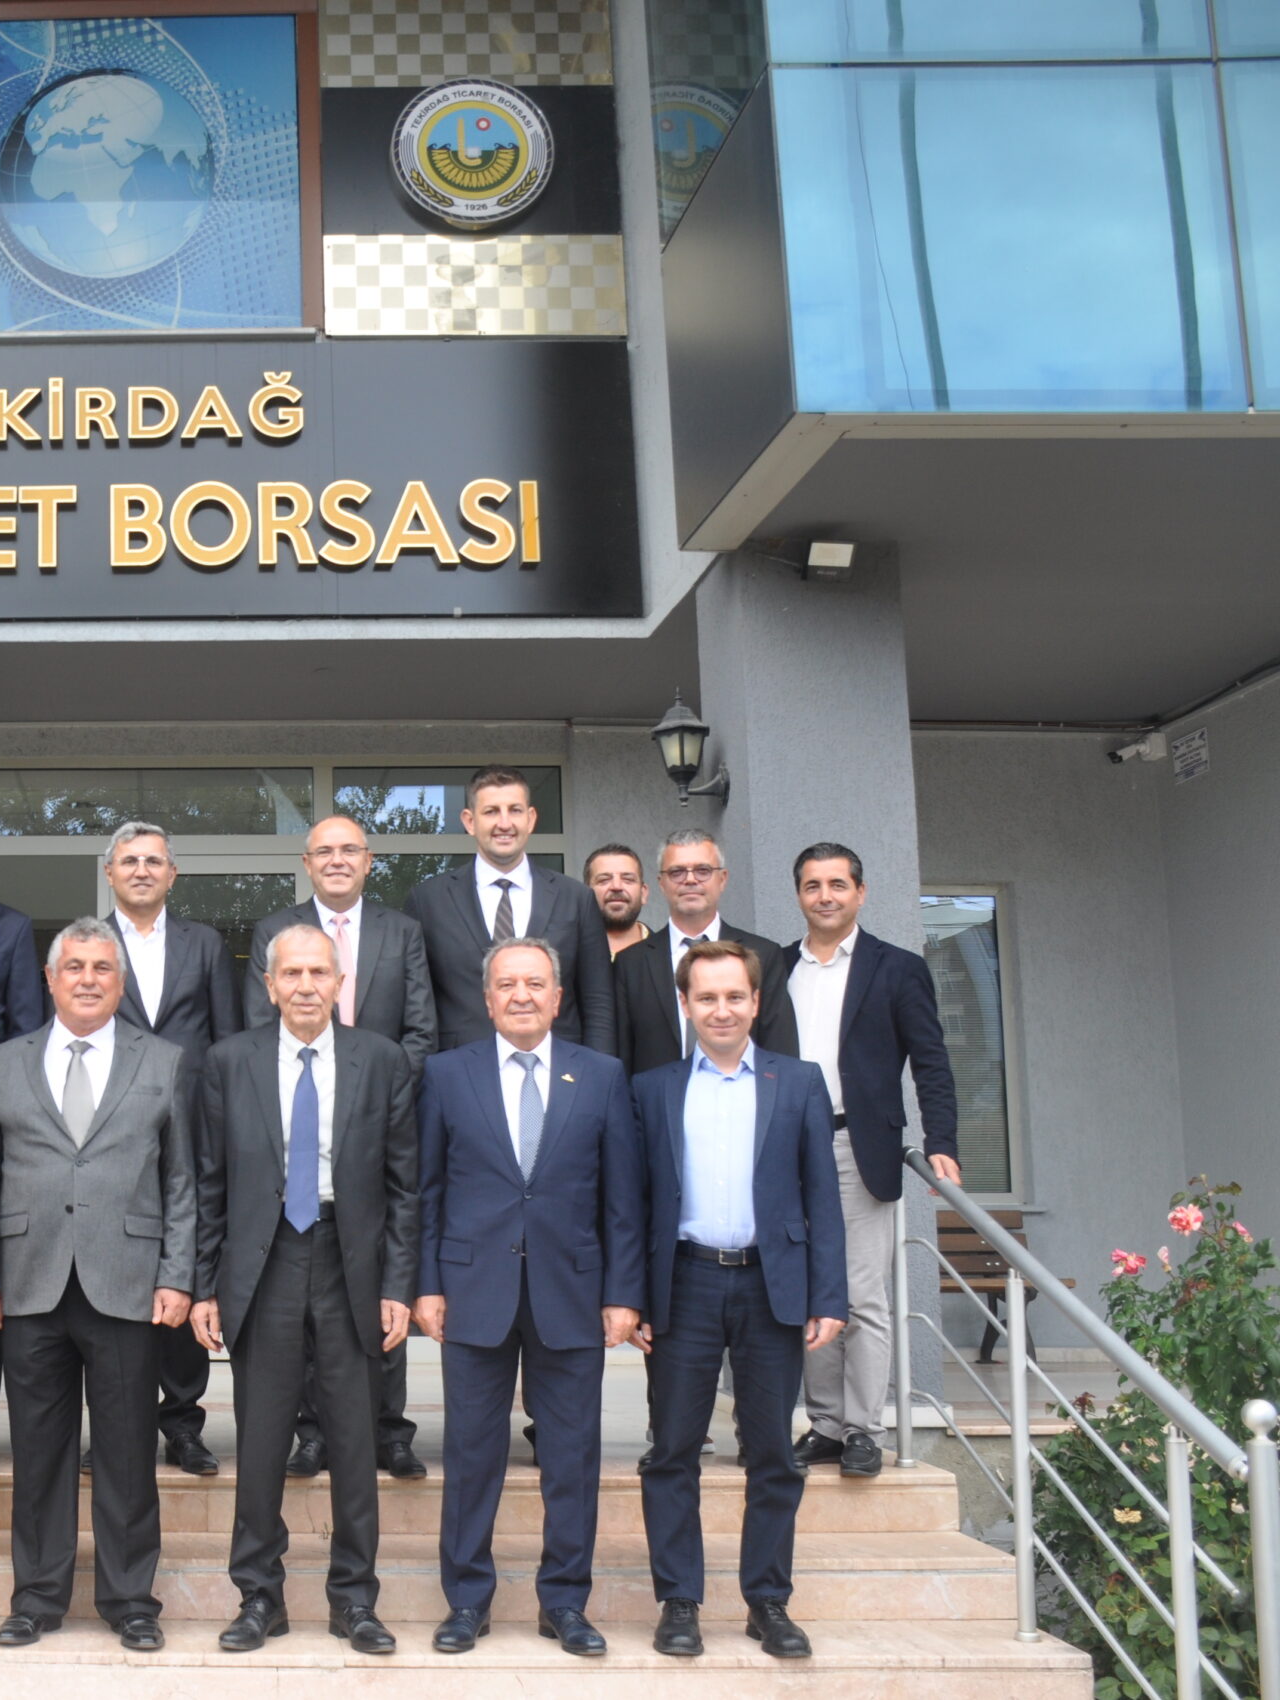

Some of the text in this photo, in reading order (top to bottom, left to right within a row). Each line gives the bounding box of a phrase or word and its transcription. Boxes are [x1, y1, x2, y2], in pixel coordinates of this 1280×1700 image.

[452, 90, 496, 100] TİCARET
[497, 96, 534, 129] BORSASI
[464, 203, 488, 211] 1926
[108, 477, 542, 569] BORSASI
